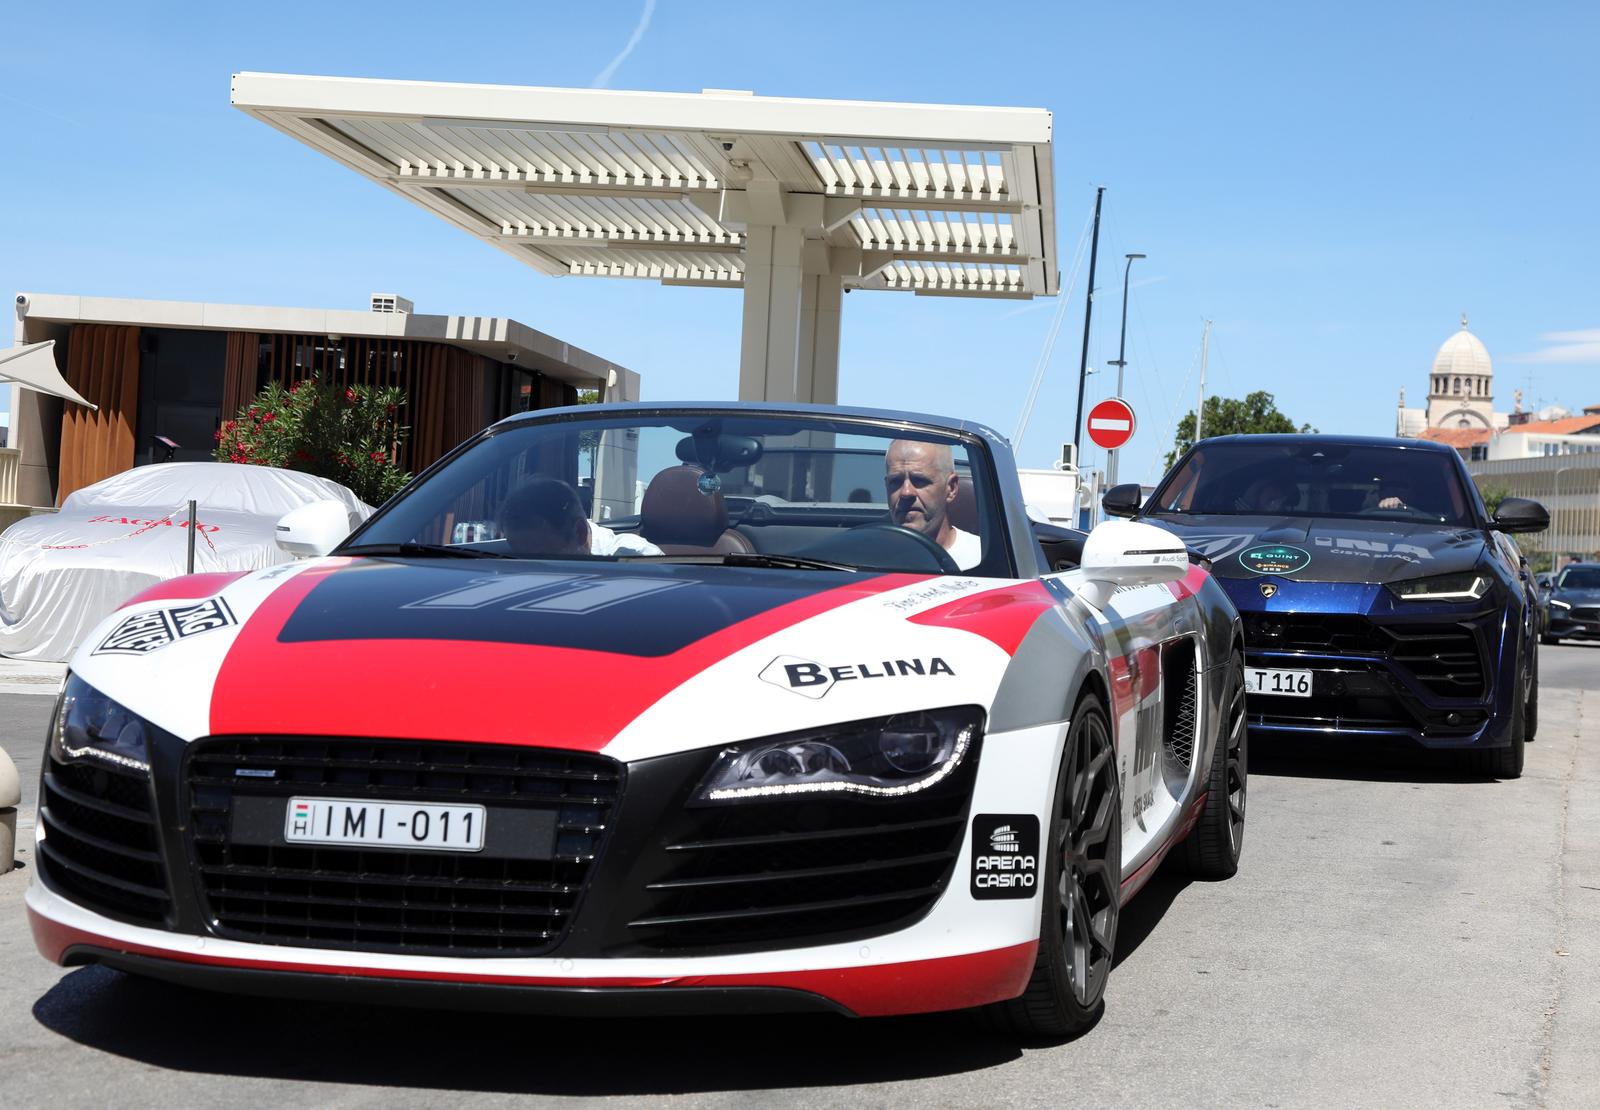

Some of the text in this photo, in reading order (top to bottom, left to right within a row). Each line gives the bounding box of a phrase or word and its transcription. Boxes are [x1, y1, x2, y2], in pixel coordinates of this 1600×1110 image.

[174, 601, 224, 637] TAG
[784, 657, 956, 688] BELINA
[1255, 671, 1309, 694] T 116
[292, 805, 474, 844] H IMI-011
[976, 855, 1035, 870] ARENA
[975, 873, 1035, 888] CASINO
